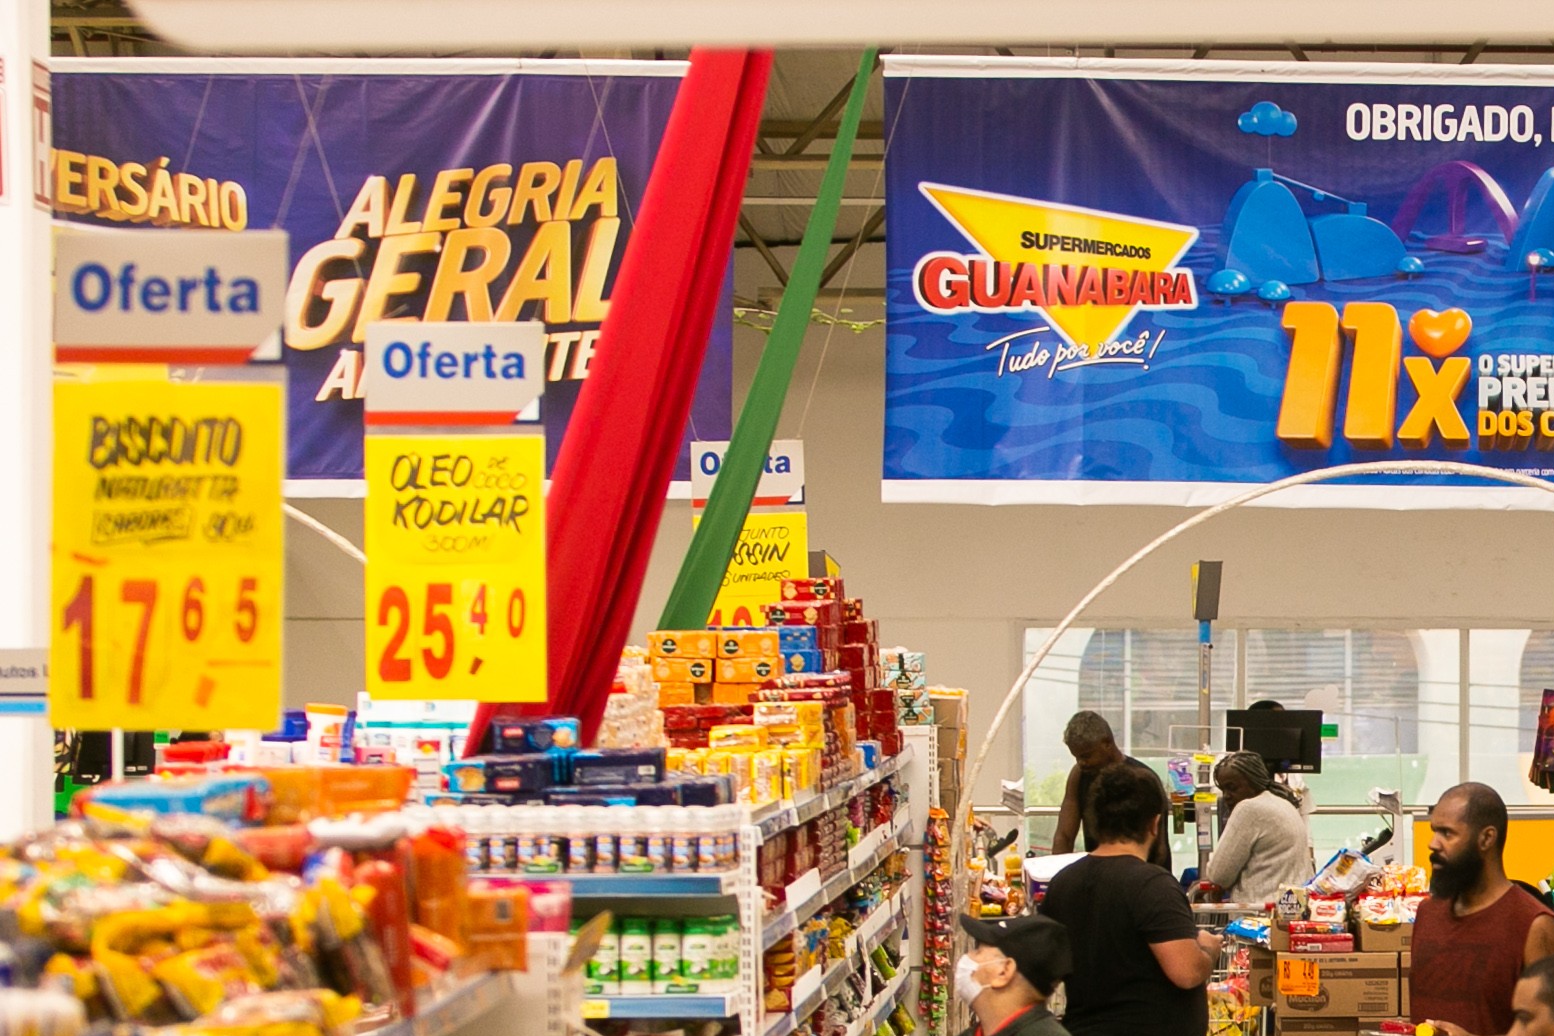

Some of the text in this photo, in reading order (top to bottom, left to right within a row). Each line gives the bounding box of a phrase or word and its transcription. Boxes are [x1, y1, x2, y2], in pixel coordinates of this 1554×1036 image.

[1345, 102, 1542, 147] OBRIGADO,
[334, 156, 618, 240] ALEGRIA
[1020, 230, 1151, 259] SUPERMERCADOS
[71, 261, 260, 314] Oferta
[284, 216, 622, 351] GERAL
[918, 256, 1193, 309] GUANABARA
[382, 341, 526, 380] Oferta
[986, 326, 1166, 378] Tudo por você!
[1478, 354, 1494, 376] O
[1477, 409, 1536, 438] DOS
[700, 451, 791, 475] Ota
[393, 495, 530, 534] KODILAR
